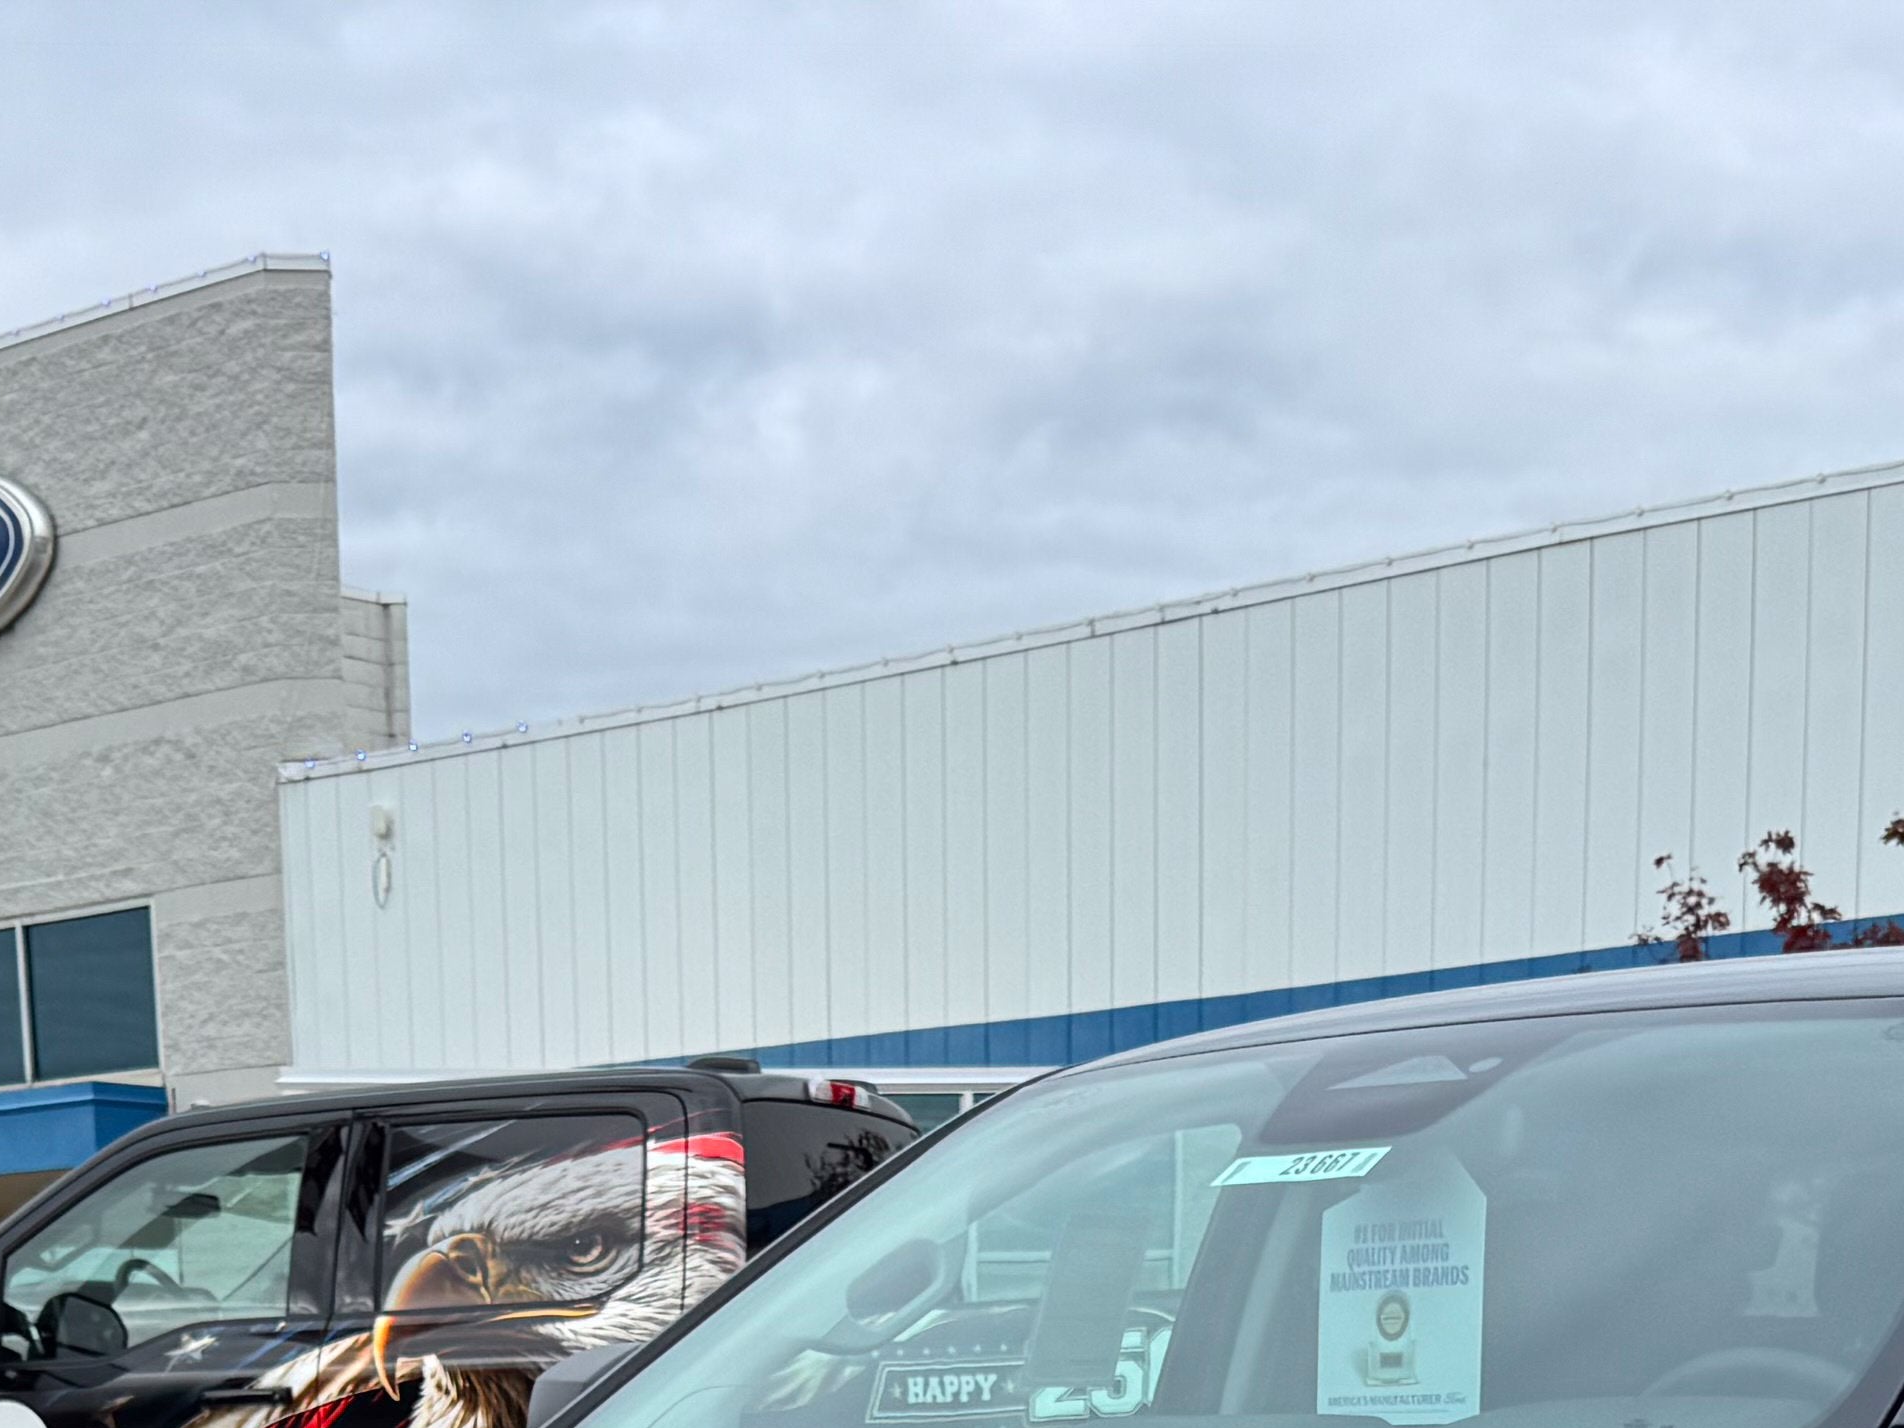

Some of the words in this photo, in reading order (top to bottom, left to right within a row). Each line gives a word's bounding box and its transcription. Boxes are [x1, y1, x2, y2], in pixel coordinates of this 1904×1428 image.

[1278, 1152, 1360, 1176] 23667
[1370, 1220, 1395, 1244] FOR
[1398, 1219, 1445, 1241] INITIAL
[1347, 1247, 1396, 1271] QUALITY
[1400, 1243, 1450, 1266] AMONG
[1329, 1268, 1411, 1292] MAINSTREAM
[1412, 1265, 1469, 1288] BRANDS
[907, 1374, 997, 1405] HAPPY
